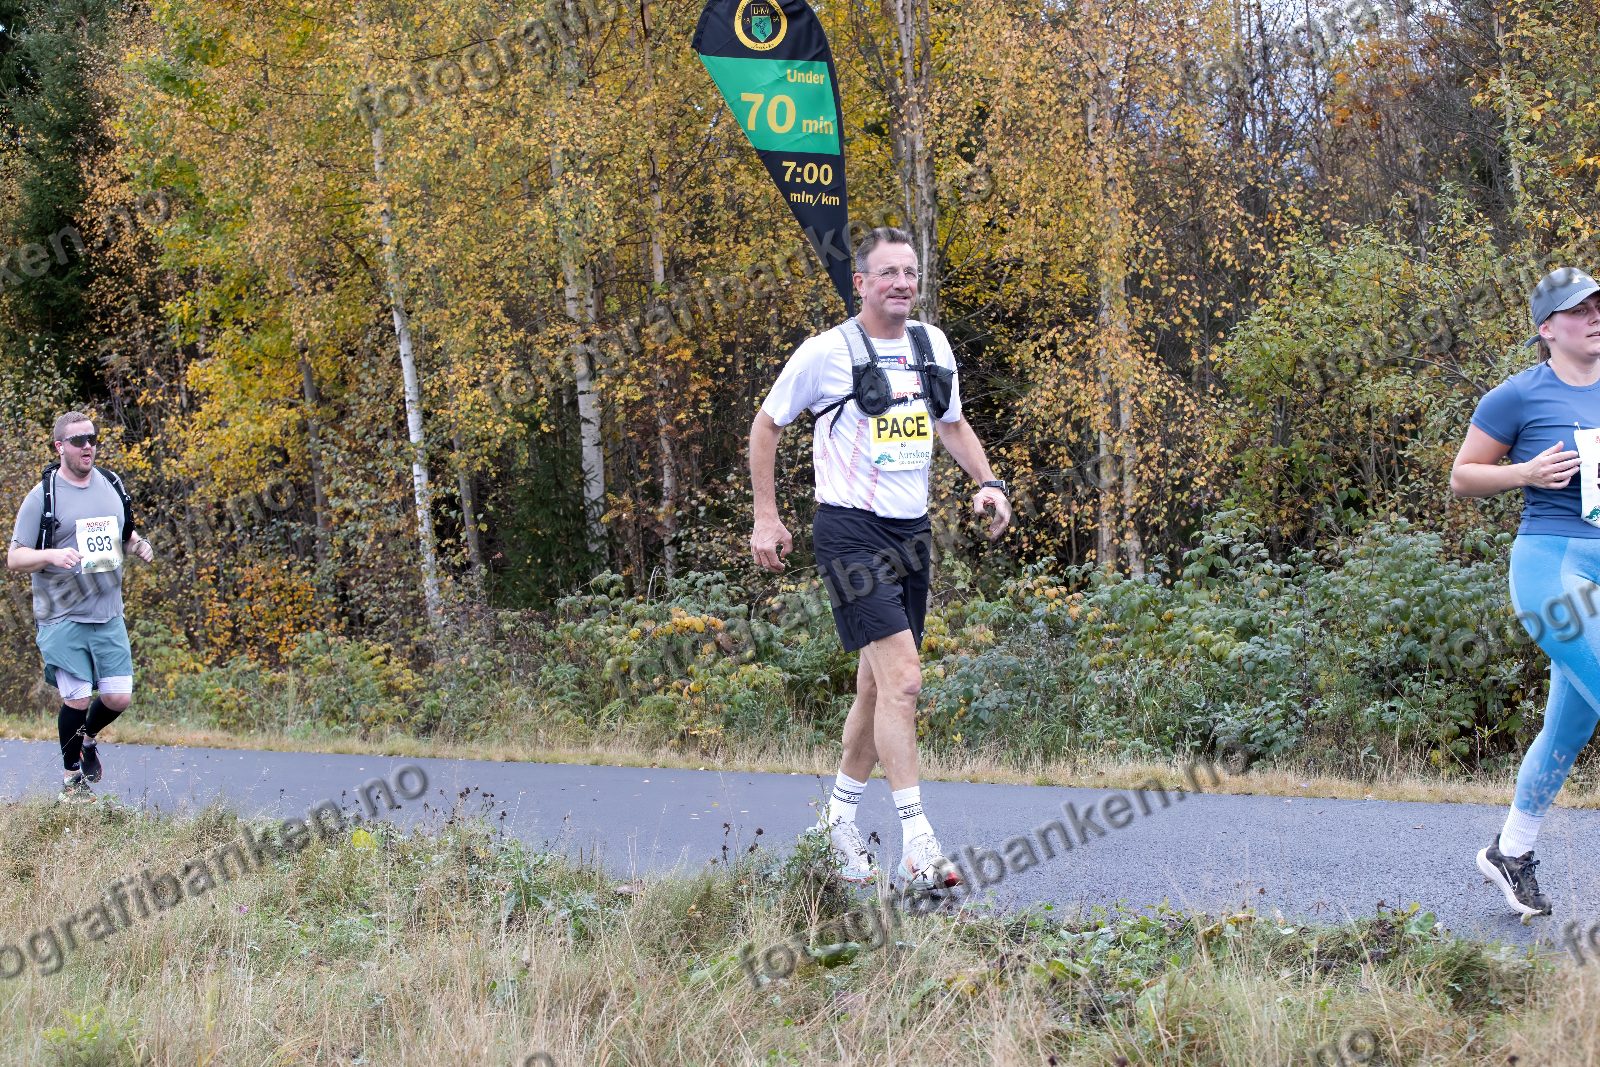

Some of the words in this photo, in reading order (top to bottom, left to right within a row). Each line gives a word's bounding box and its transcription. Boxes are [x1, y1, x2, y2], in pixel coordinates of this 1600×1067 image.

[786, 69, 825, 85] Under
[740, 92, 797, 134] 70
[802, 115, 834, 135] min
[782, 160, 833, 186] 7:00
[790, 190, 840, 206] min/km
[876, 416, 928, 439] PACE
[86, 535, 112, 552] 693
